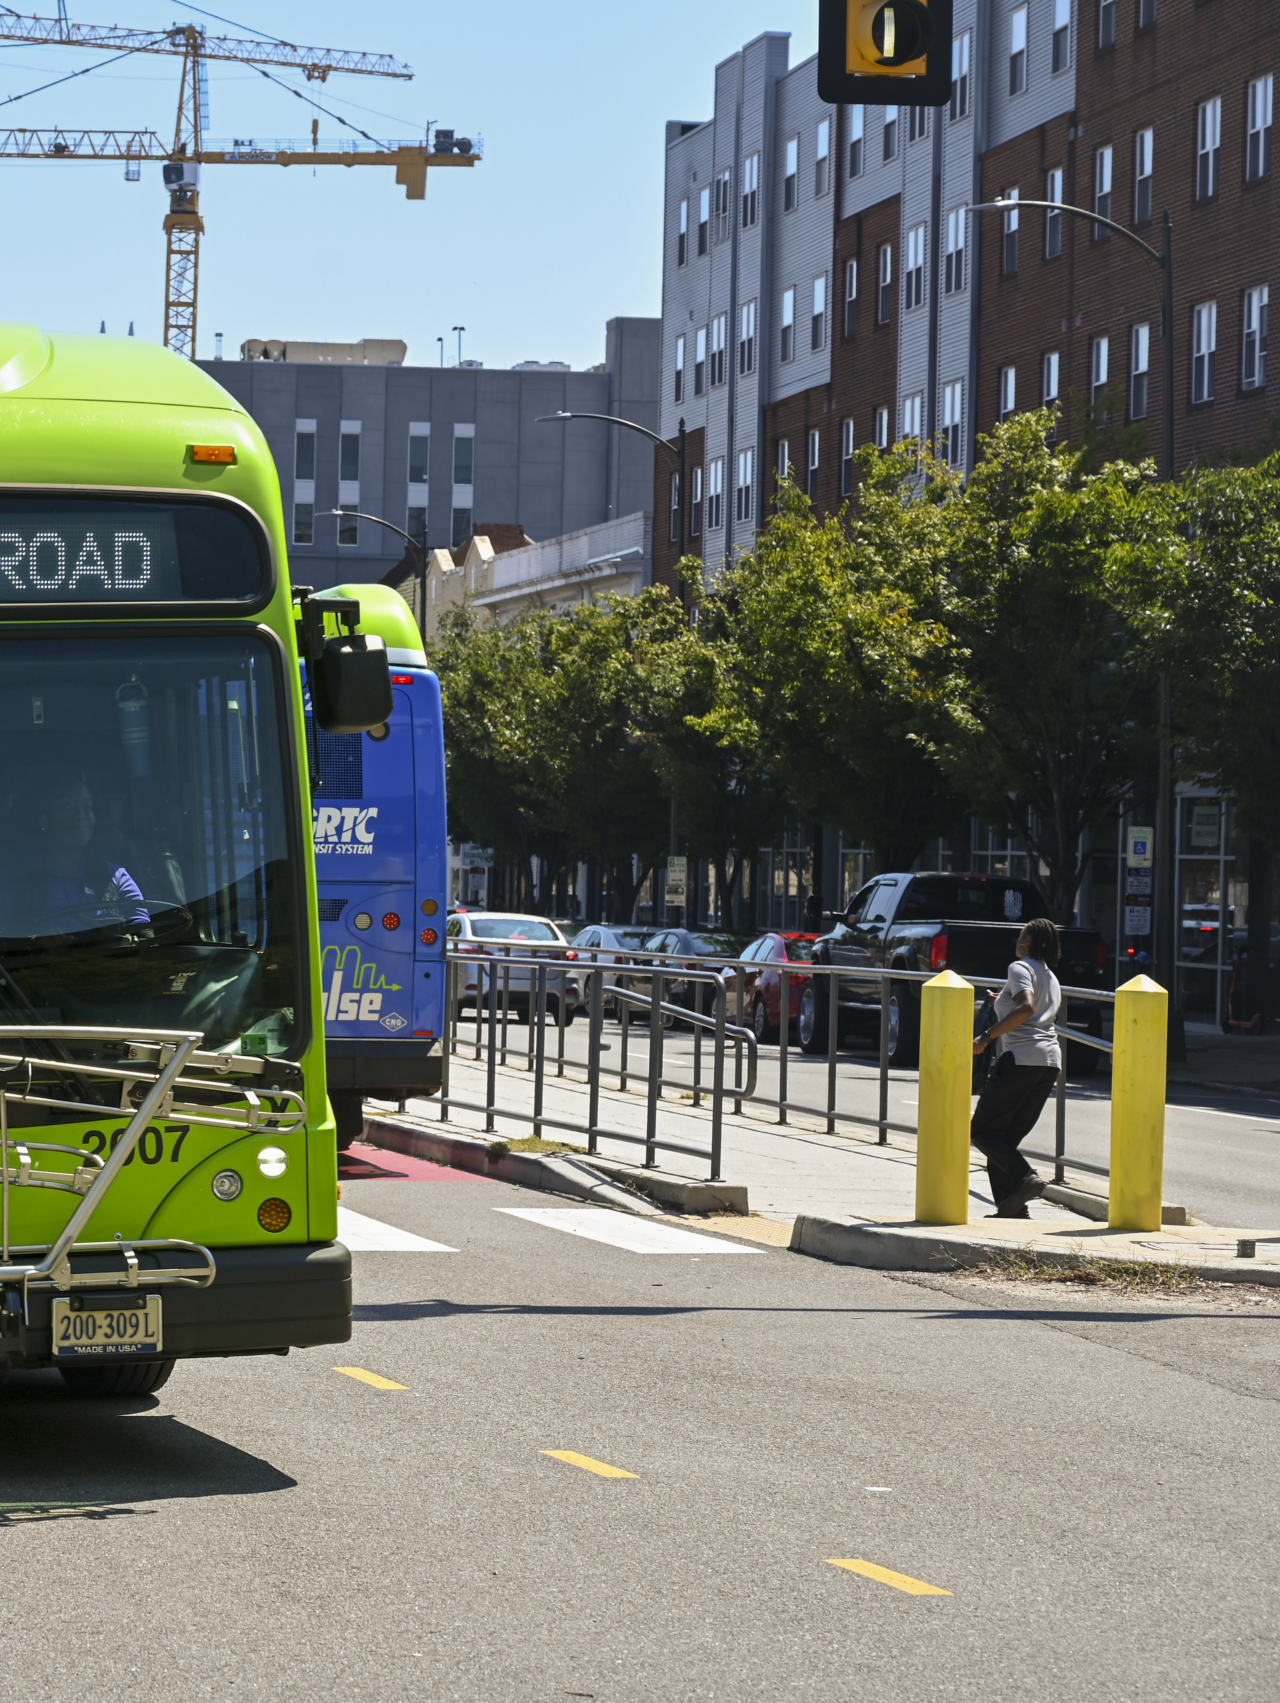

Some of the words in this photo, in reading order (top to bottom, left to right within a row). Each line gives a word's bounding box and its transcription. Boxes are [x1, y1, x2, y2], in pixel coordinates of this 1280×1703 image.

[335, 844, 373, 854] SYSTEM
[385, 1018, 402, 1026] CNG
[76, 1345, 104, 1354] MADE
[106, 1345, 116, 1353] IN
[118, 1344, 138, 1353] USA
